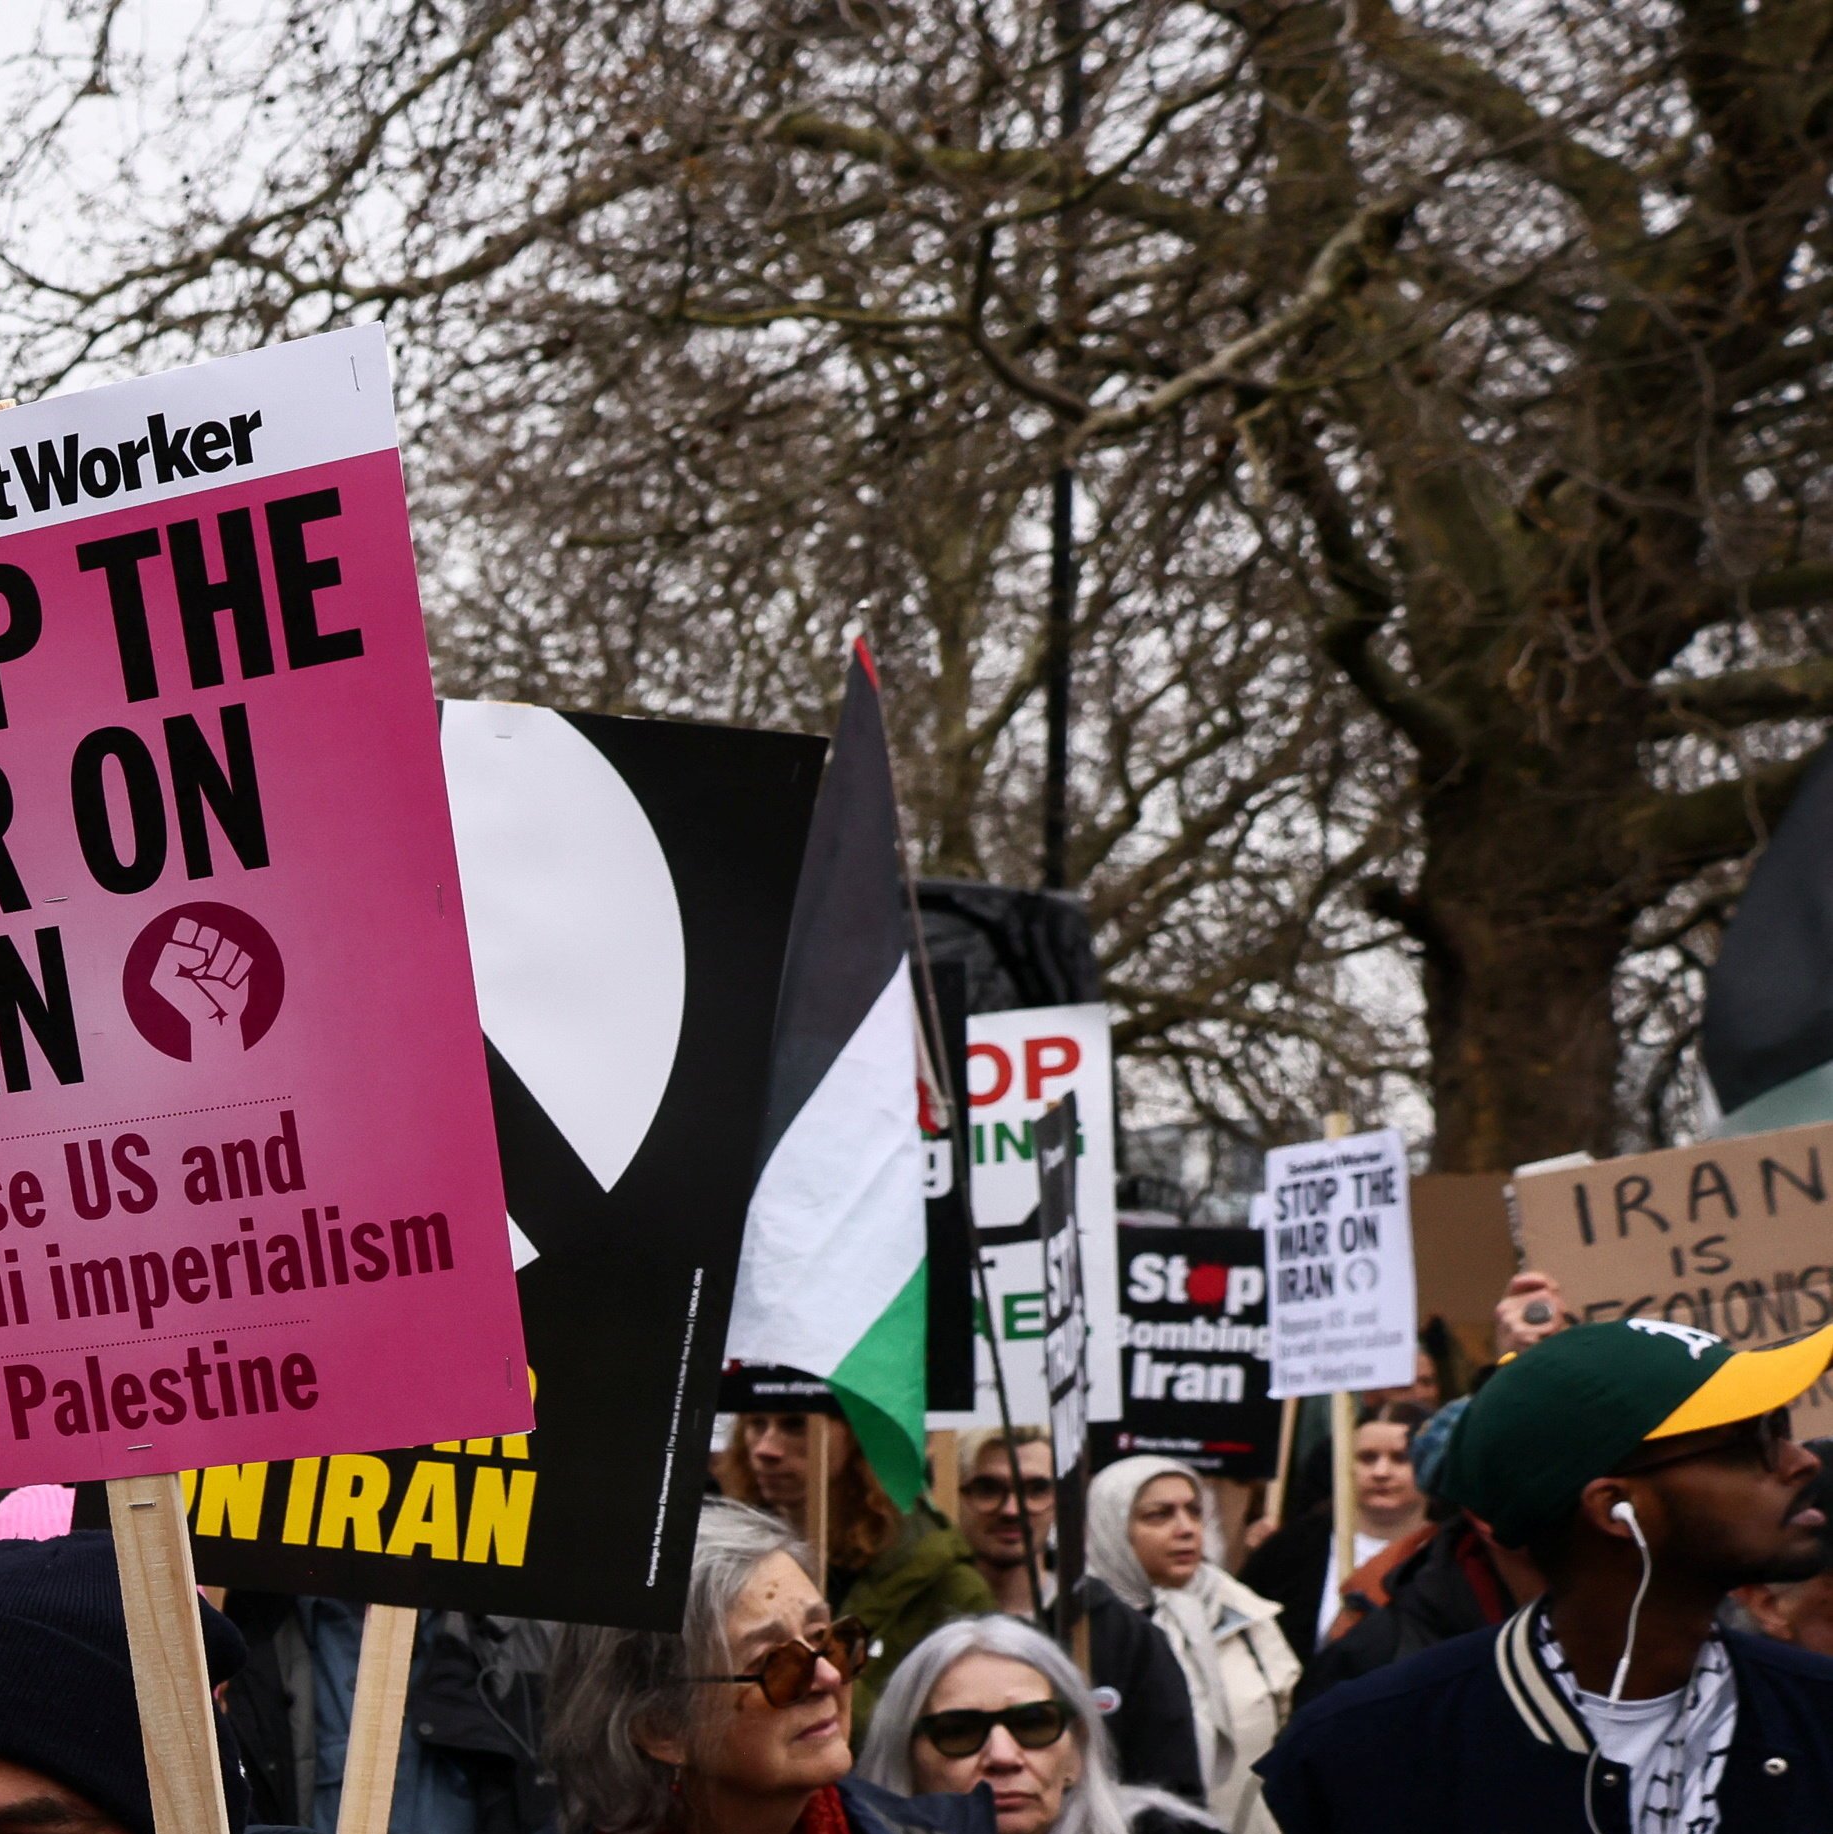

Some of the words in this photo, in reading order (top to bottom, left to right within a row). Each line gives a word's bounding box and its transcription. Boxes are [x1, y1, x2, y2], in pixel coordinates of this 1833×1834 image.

[77, 486, 364, 704] THE
[70, 702, 271, 895] ON
[63, 1131, 159, 1223] US
[184, 1110, 307, 1201] and
[1276, 1176, 1338, 1221] STOP
[1352, 1166, 1398, 1210] THE
[1573, 1146, 1827, 1246] IRAN
[47, 1205, 454, 1329] imperialism
[1276, 1221, 1328, 1262] WAR
[1340, 1214, 1379, 1254] ON
[1277, 1262, 1334, 1305] IRAN
[1670, 1234, 1733, 1278] IS
[12, 1340, 320, 1442] Palestine
[1130, 1352, 1245, 1403] Iran
[180, 1461, 269, 1540] N
[282, 1454, 538, 1567] IRAN
